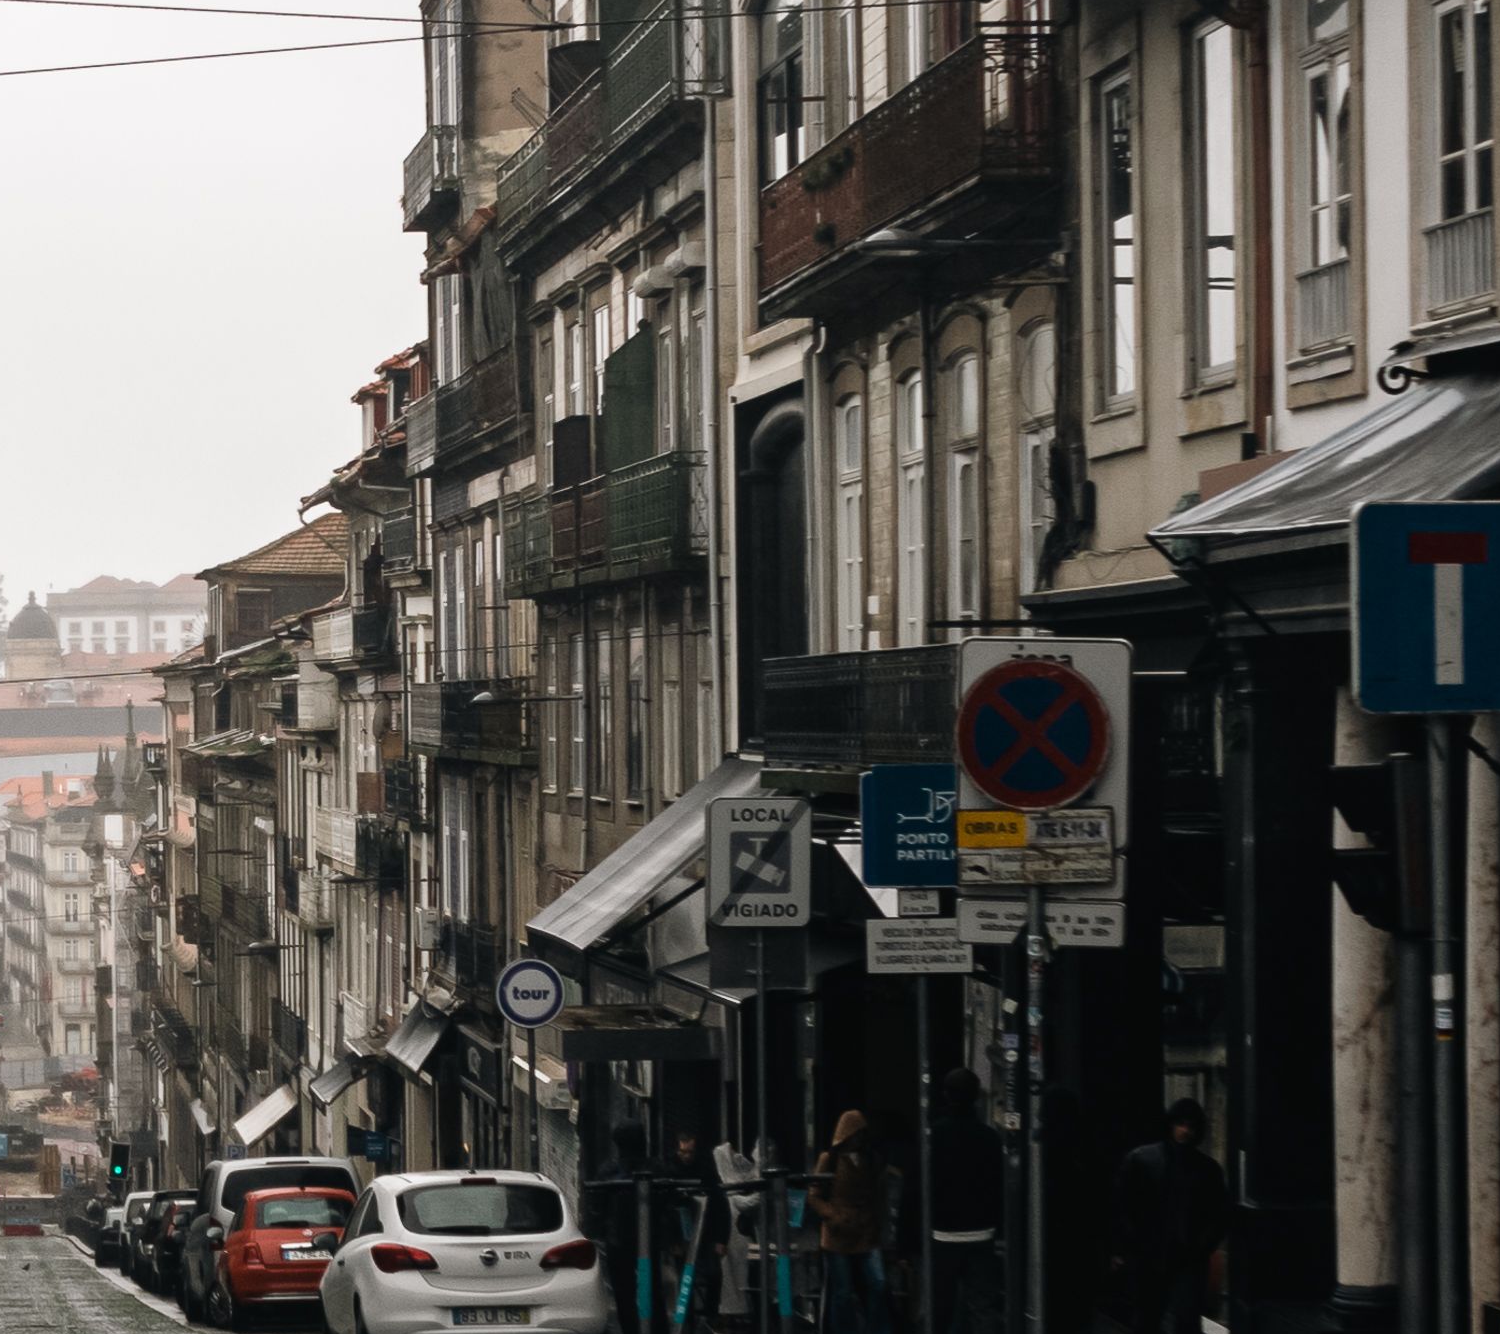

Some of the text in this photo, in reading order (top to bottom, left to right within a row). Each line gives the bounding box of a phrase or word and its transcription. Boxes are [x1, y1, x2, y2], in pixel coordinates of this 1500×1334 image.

[731, 808, 791, 823] LOCAL
[964, 821, 1018, 835] OBRAS
[896, 833, 950, 845] PONTO
[721, 903, 799, 918] VIGIADO
[512, 986, 550, 1001] tour
